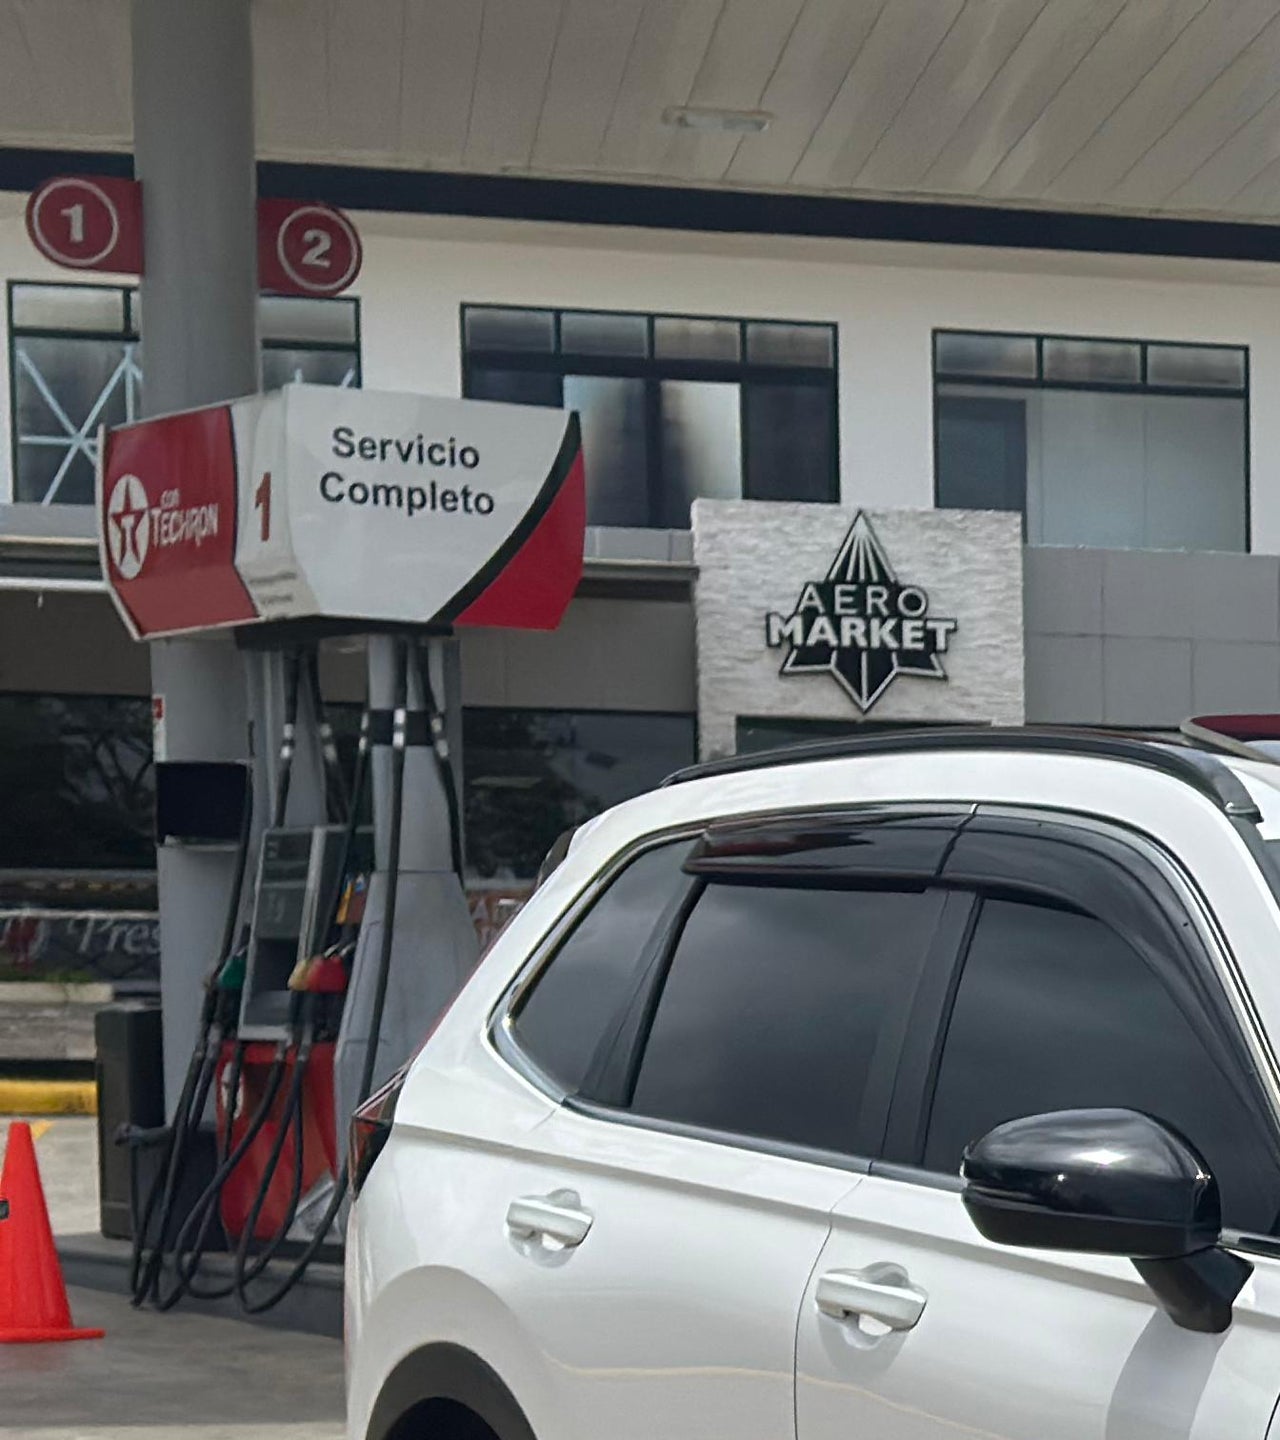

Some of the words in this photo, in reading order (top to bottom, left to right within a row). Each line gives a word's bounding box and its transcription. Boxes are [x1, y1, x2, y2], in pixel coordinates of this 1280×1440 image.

[61, 203, 85, 242] 1
[302, 229, 332, 268] 2
[331, 425, 480, 469] Servicio
[255, 471, 272, 542] 1
[319, 471, 495, 517] Completo
[152, 503, 219, 548] TECHRON
[798, 583, 928, 618] AERO
[767, 614, 957, 651] MARKET
